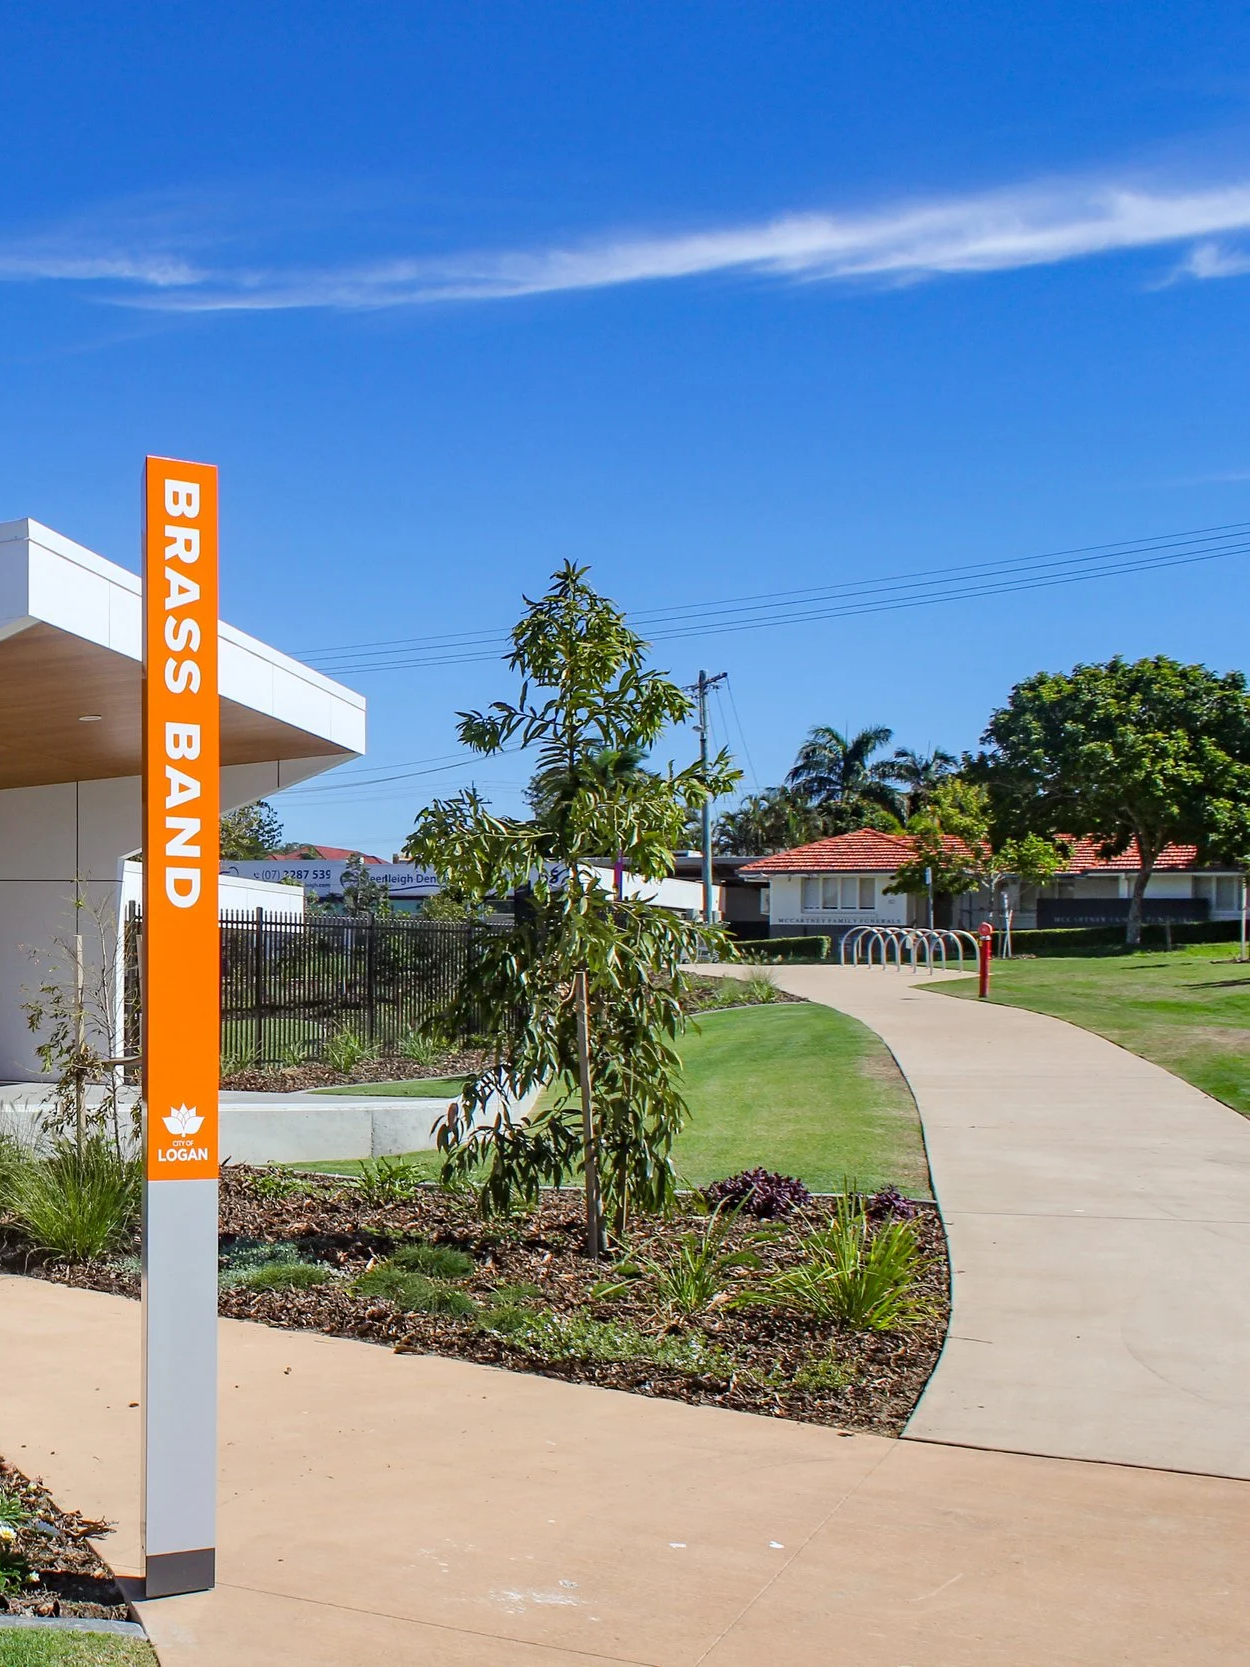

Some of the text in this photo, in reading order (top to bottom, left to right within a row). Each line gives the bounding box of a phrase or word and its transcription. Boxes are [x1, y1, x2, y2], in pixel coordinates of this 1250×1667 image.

[164, 478, 201, 909] BRASS BAND
[262, 869, 280, 881] (07)
[368, 874, 413, 885] eenleigh
[158, 1148, 208, 1162] LOGAN
